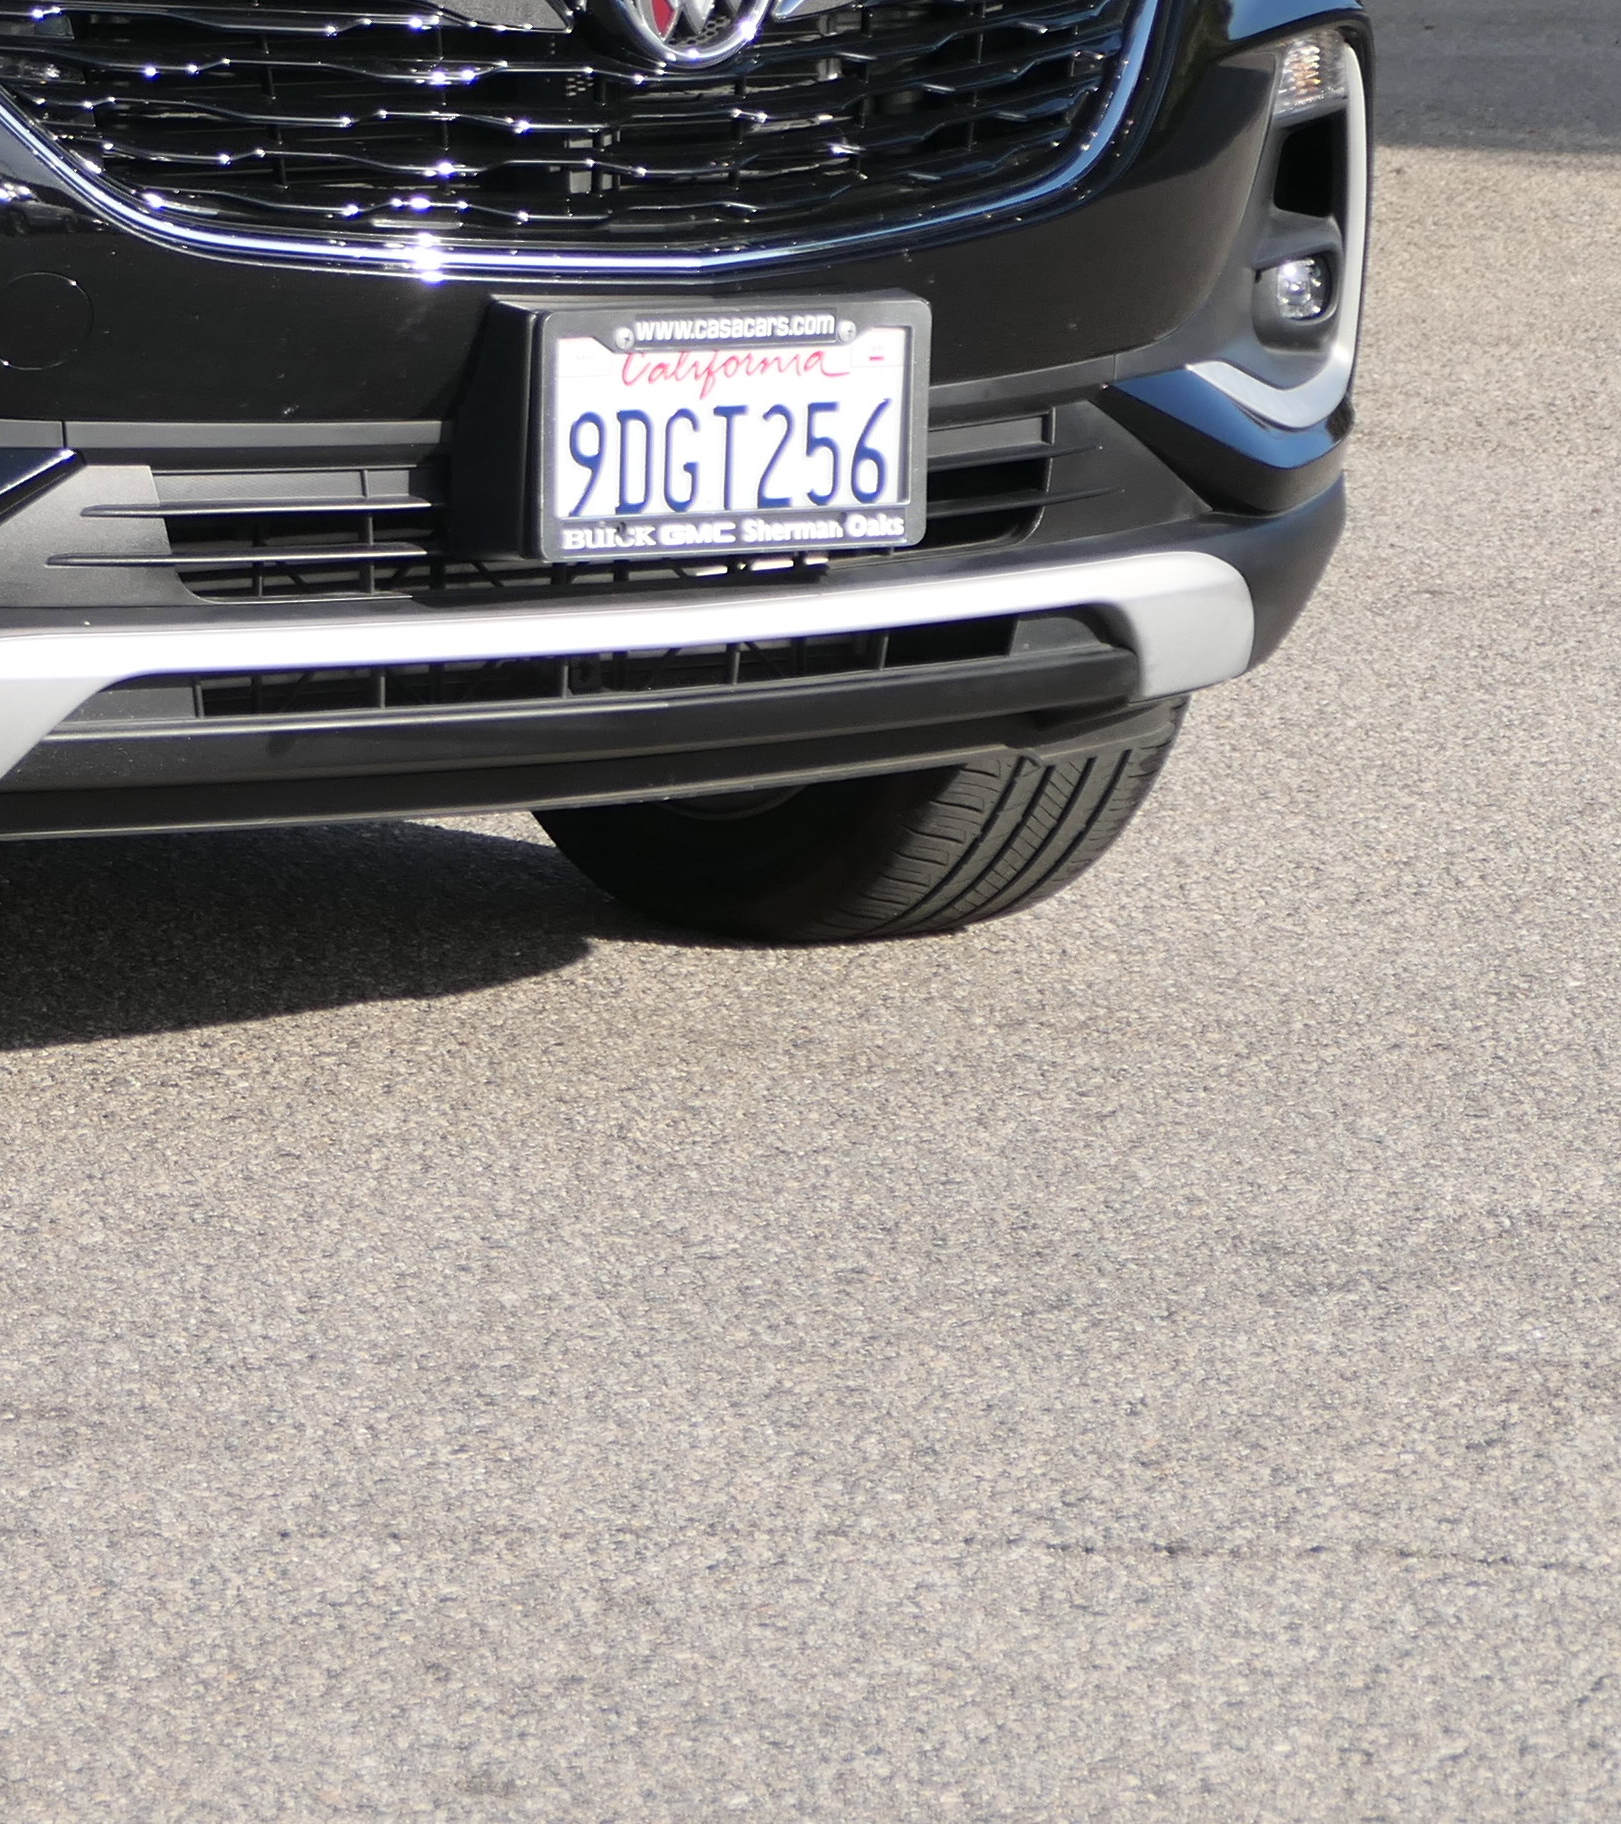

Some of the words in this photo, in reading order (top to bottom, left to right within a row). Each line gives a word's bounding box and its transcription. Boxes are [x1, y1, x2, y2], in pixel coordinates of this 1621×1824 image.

[635, 314, 836, 342] www.casacars.com
[621, 350, 851, 399] California
[568, 397, 893, 518] 9DGT256
[562, 520, 657, 550] BUICK
[659, 522, 737, 546] GMC
[742, 519, 844, 544] Sherman
[846, 513, 905, 538] Oaks
